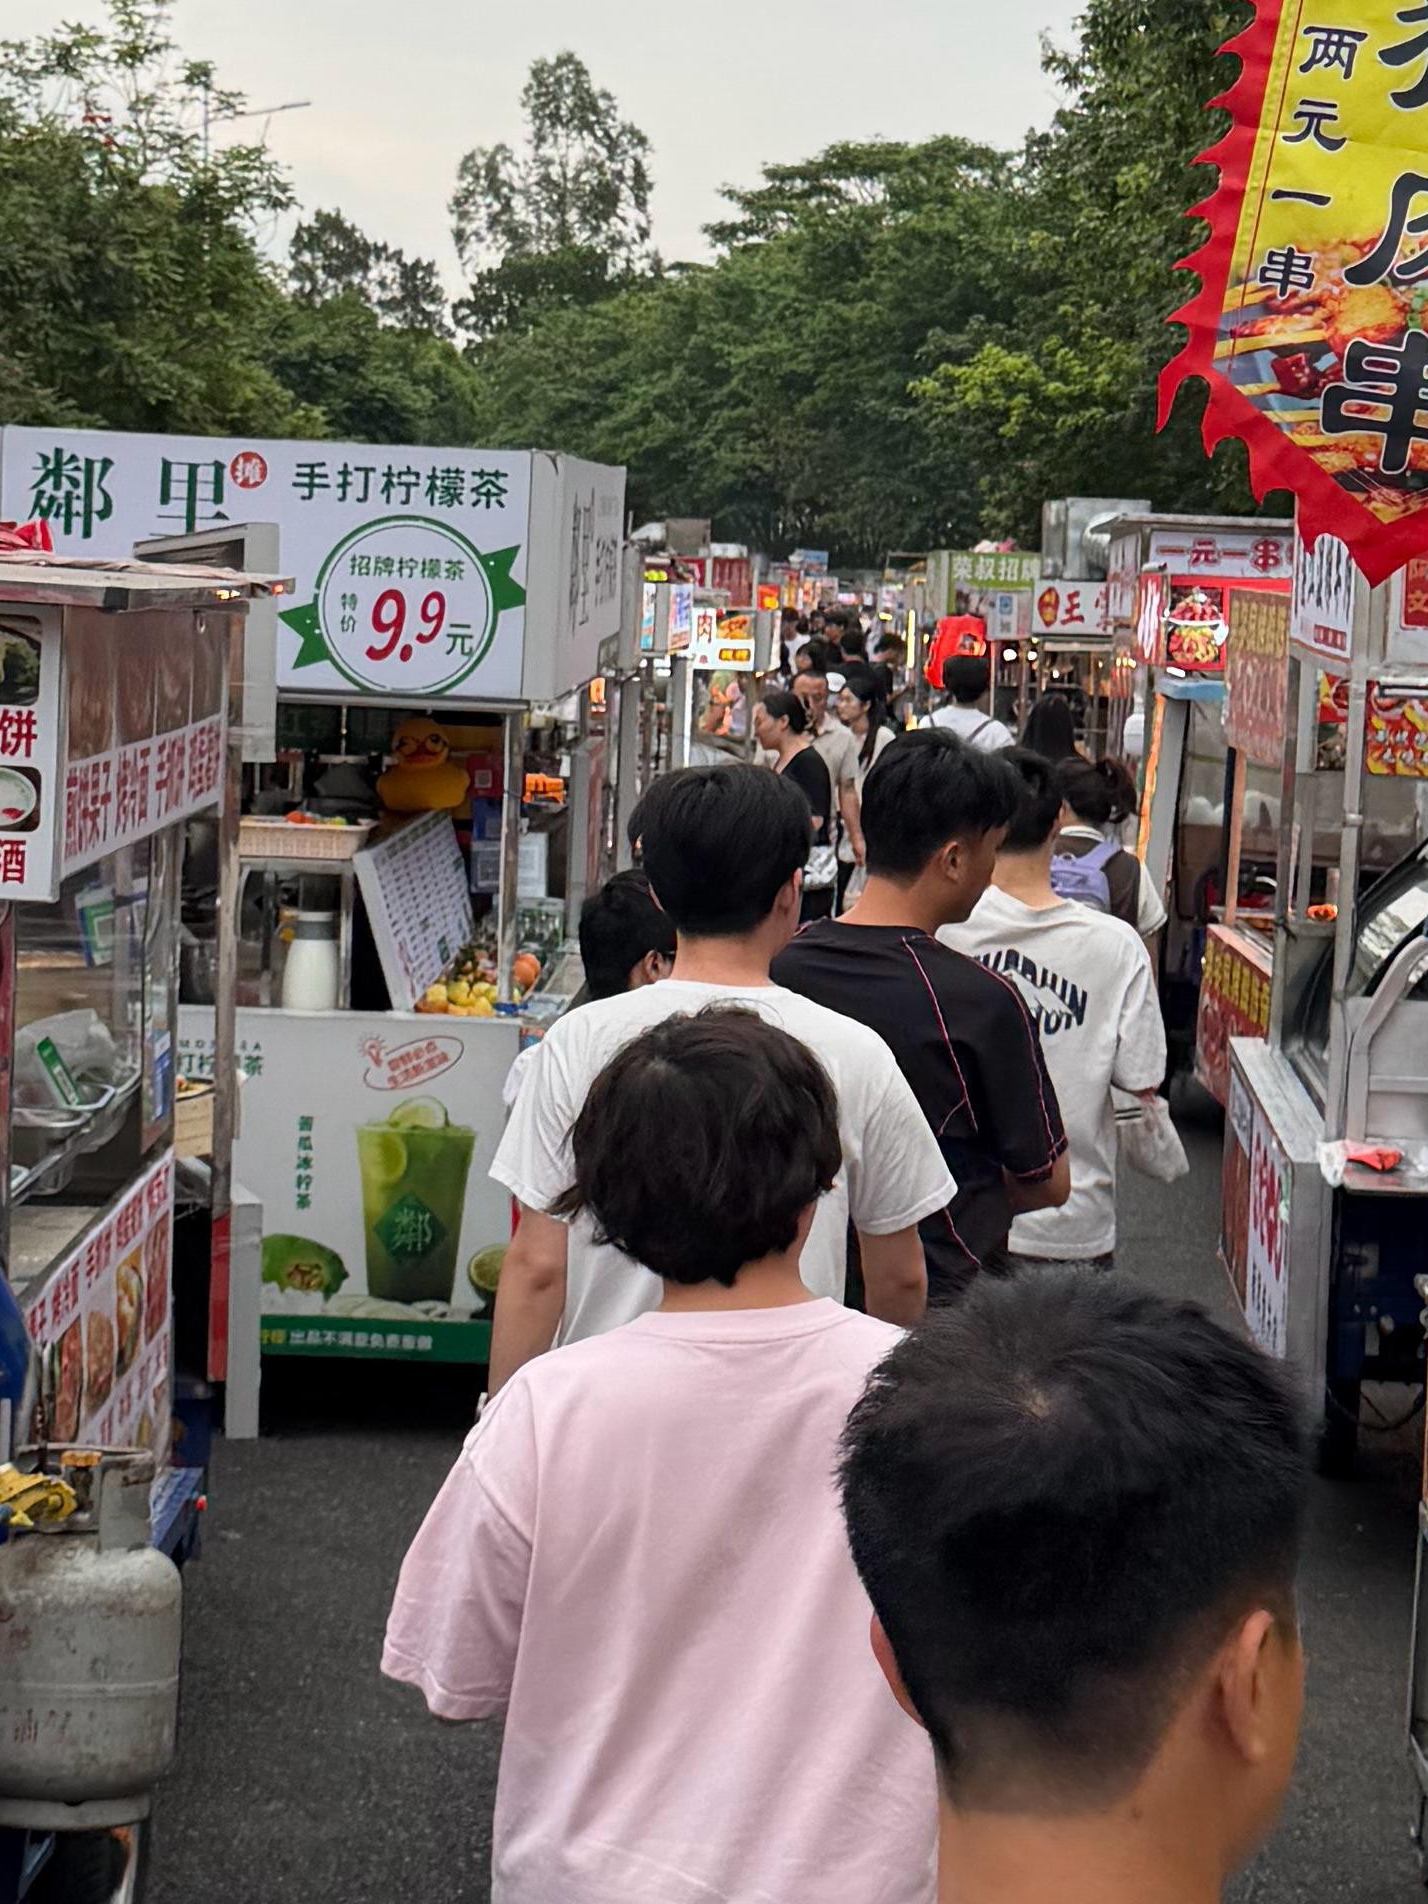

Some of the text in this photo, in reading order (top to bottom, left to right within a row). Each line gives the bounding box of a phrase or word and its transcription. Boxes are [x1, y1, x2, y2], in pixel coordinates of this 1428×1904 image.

[1256, 24, 1368, 300] 两元一串
[291, 460, 510, 510] 手打柠檬茶
[349, 552, 467, 582] 招牌柠檬茶
[1157, 538, 1284, 573] 一元一串
[340, 592, 358, 635] 特价
[365, 587, 475, 663] 9.9 元
